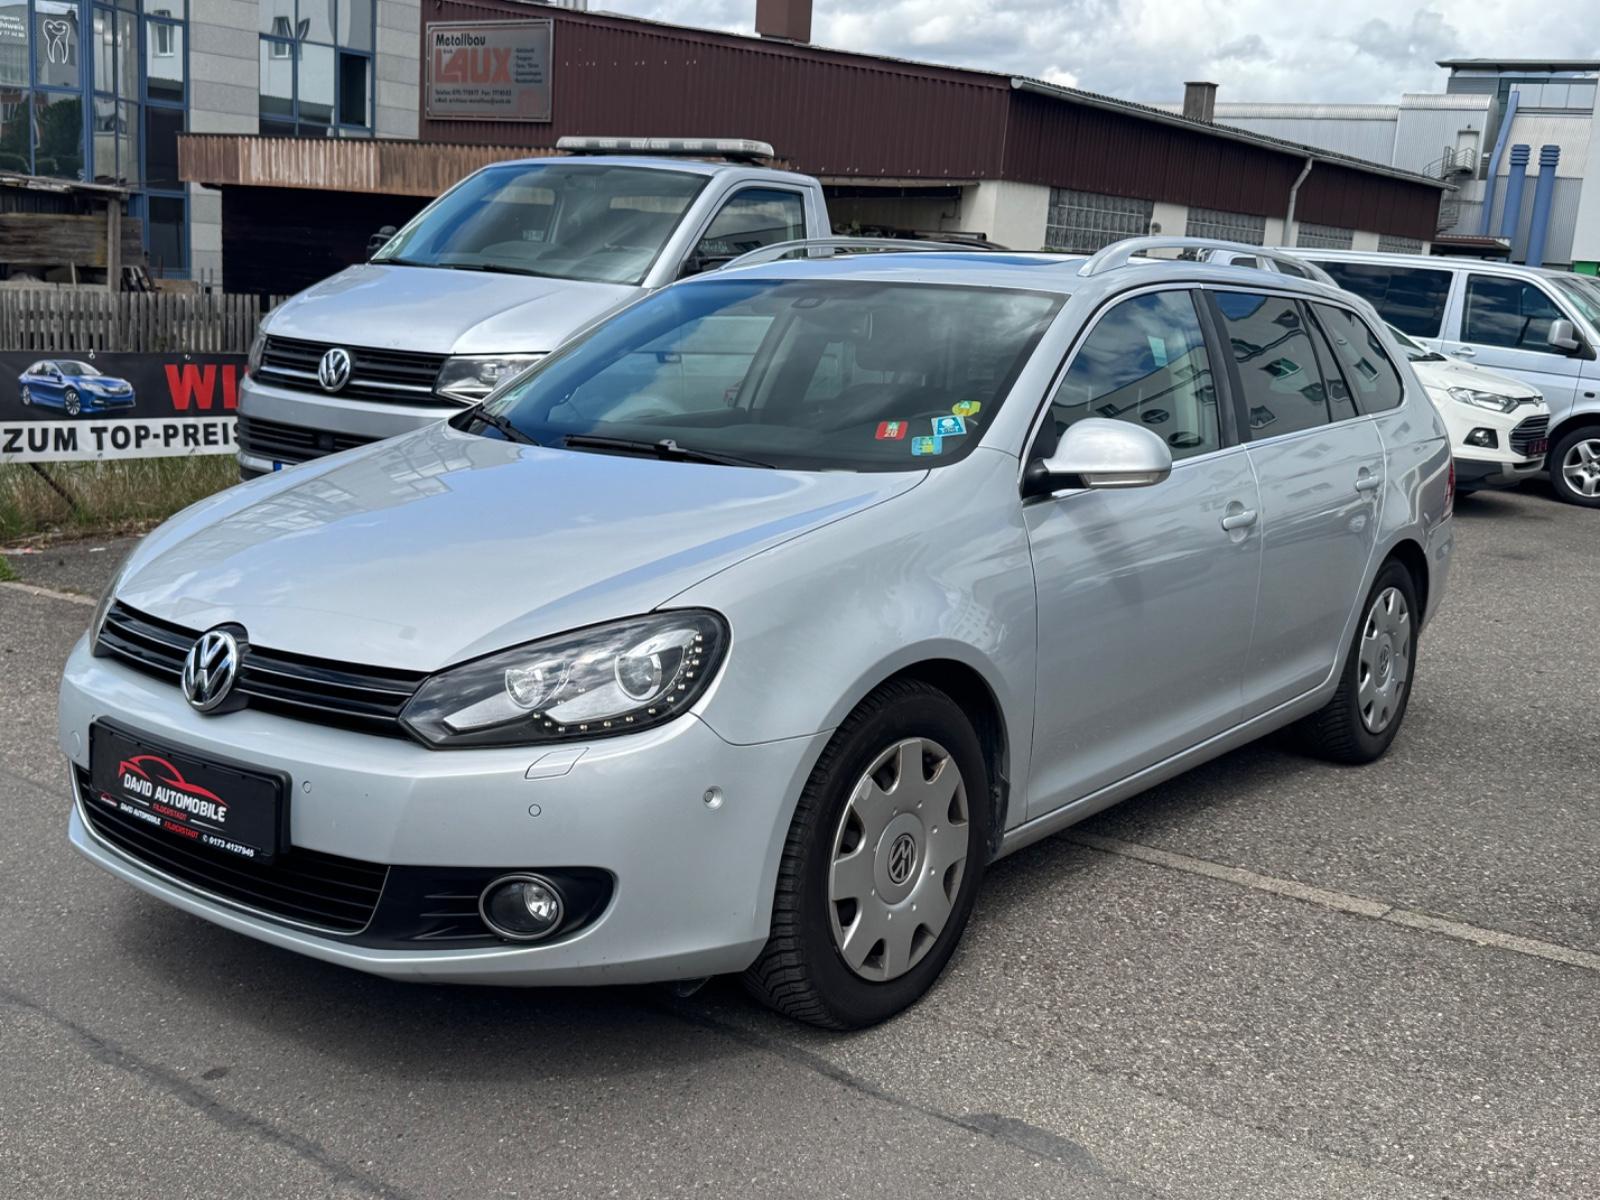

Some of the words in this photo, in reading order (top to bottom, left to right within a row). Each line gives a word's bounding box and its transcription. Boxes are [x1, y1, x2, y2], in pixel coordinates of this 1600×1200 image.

[435, 33, 486, 47] Metallbau
[435, 48, 512, 83] LAUX
[164, 364, 247, 410] WI
[3, 427, 78, 453] ZUM
[182, 630, 238, 710] VW
[123, 773, 152, 797] DAVID
[154, 786, 227, 822] AUTOMOBILE
[208, 836, 226, 849] 0173
